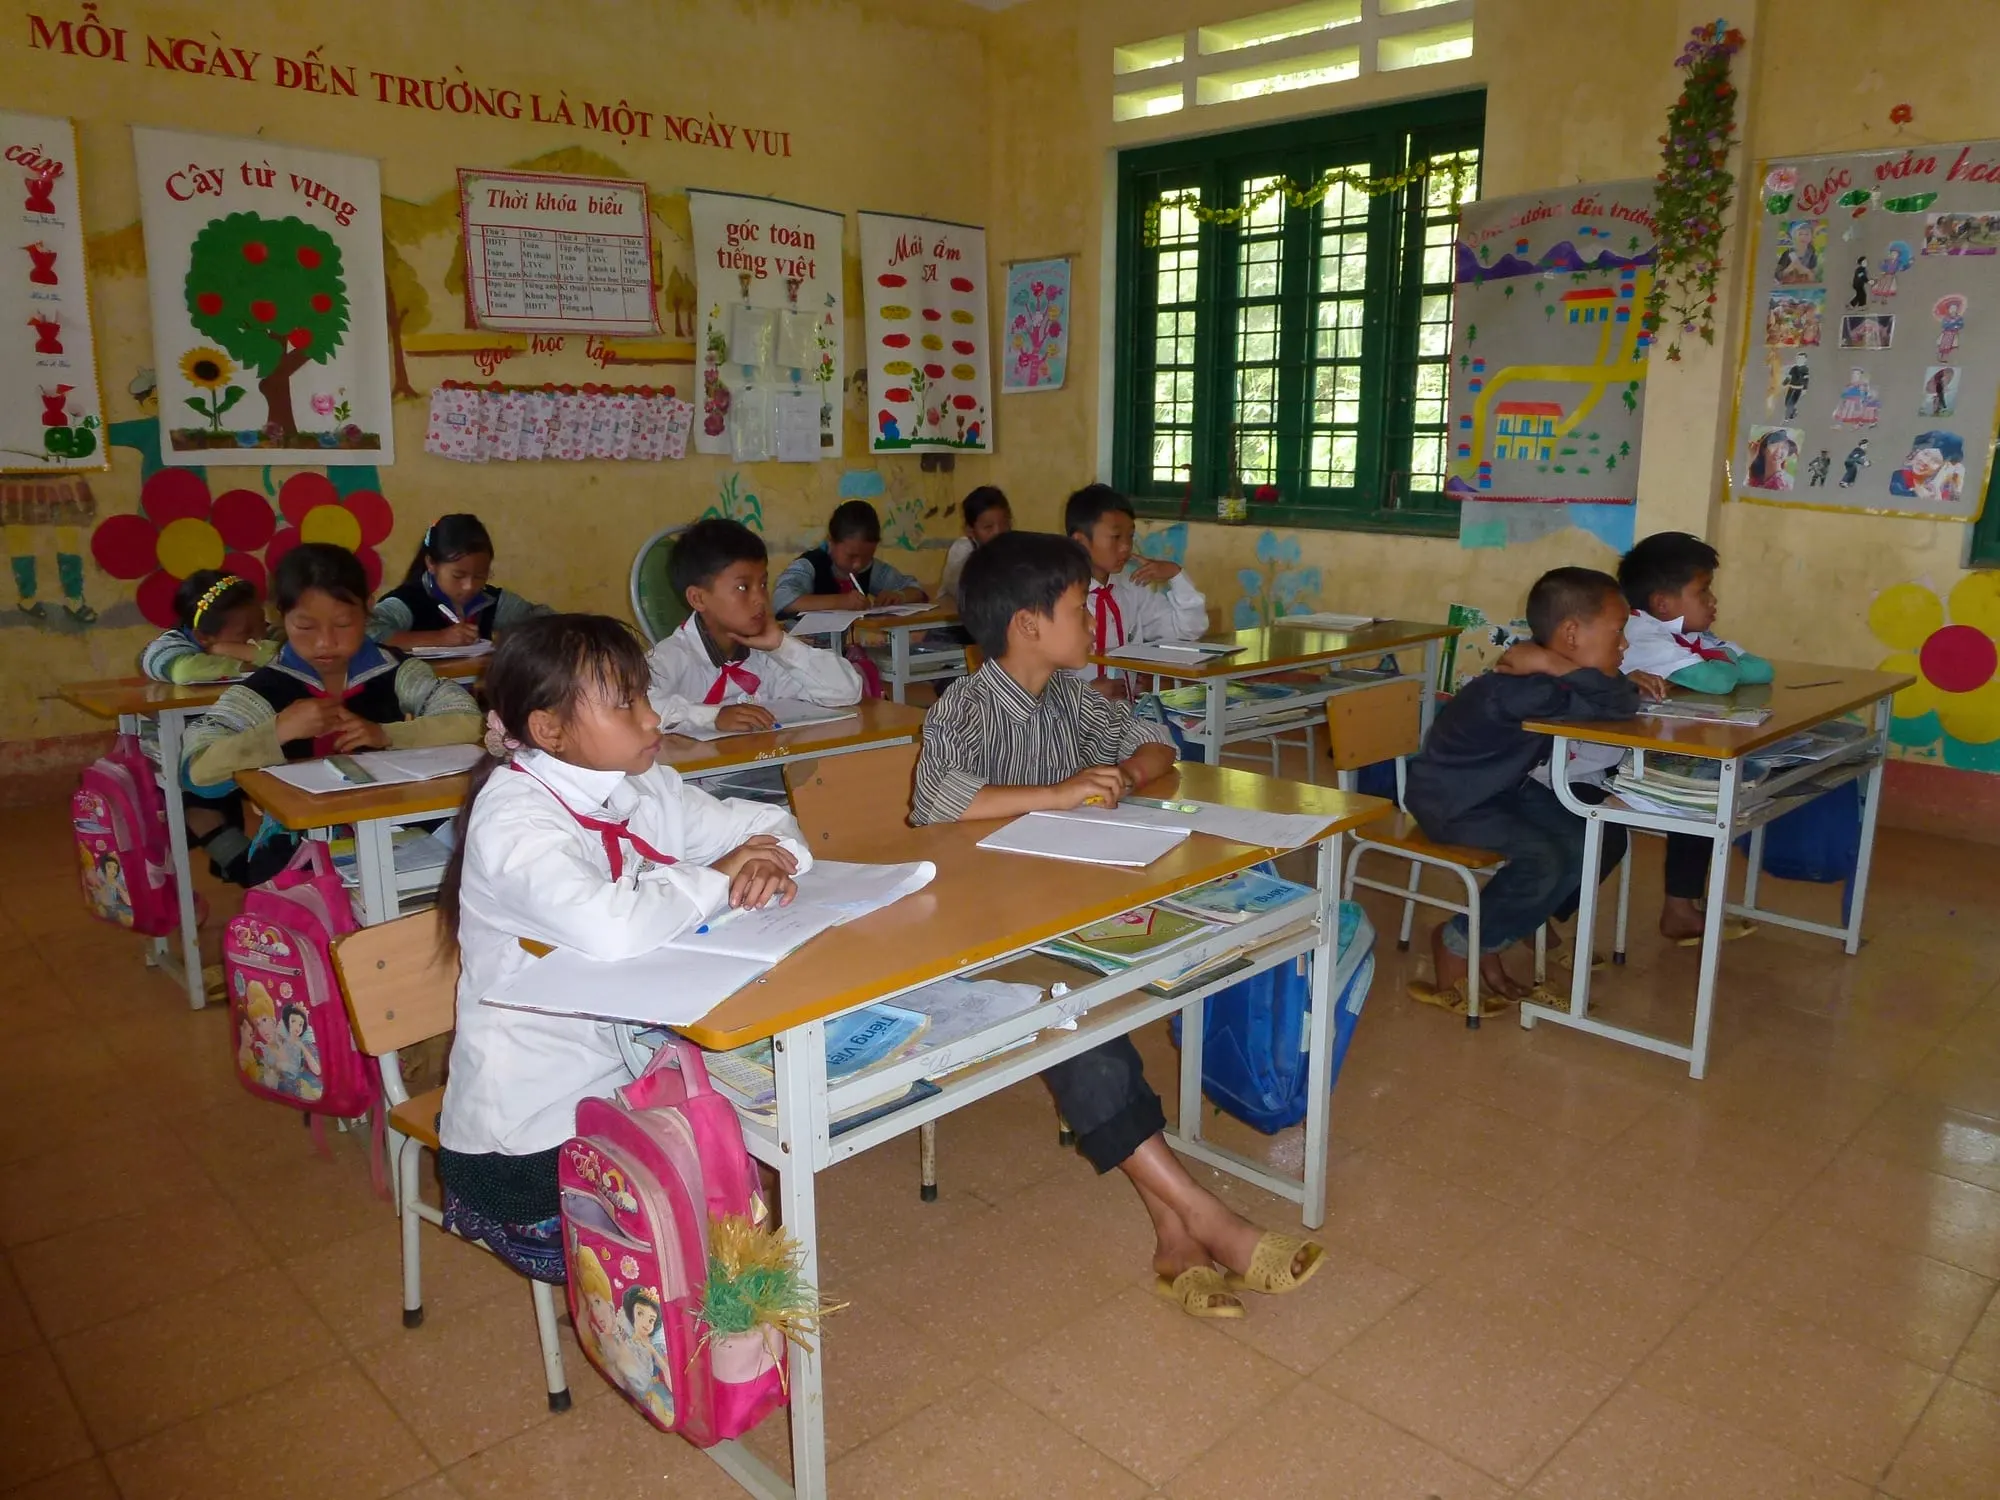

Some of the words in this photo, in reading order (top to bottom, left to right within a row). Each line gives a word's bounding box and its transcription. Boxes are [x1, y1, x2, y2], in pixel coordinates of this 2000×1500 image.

[26, 2, 128, 62] MỖI
[146, 31, 261, 82] NGÀY
[273, 45, 358, 97] ĐẾN
[371, 65, 523, 120] TRƯỜNG
[531, 90, 576, 127] LÀ
[584, 100, 653, 146] MỘT
[664, 111, 737, 151] NGÀY
[743, 127, 793, 158] VUI
[165, 162, 225, 202] Cây
[240, 159, 277, 189] từ
[289, 172, 358, 227] vựng
[486, 188, 528, 213] Thời
[536, 191, 578, 214] khóa
[588, 191, 624, 216] biểu
[727, 218, 759, 247] góc
[770, 224, 815, 250] toán
[933, 234, 961, 262] ấm
[717, 246, 768, 279] tiếng
[775, 255, 817, 284] việt
[532, 333, 564, 357] học
[586, 334, 616, 370] tập
[850, 1015, 900, 1046] Tiếng
